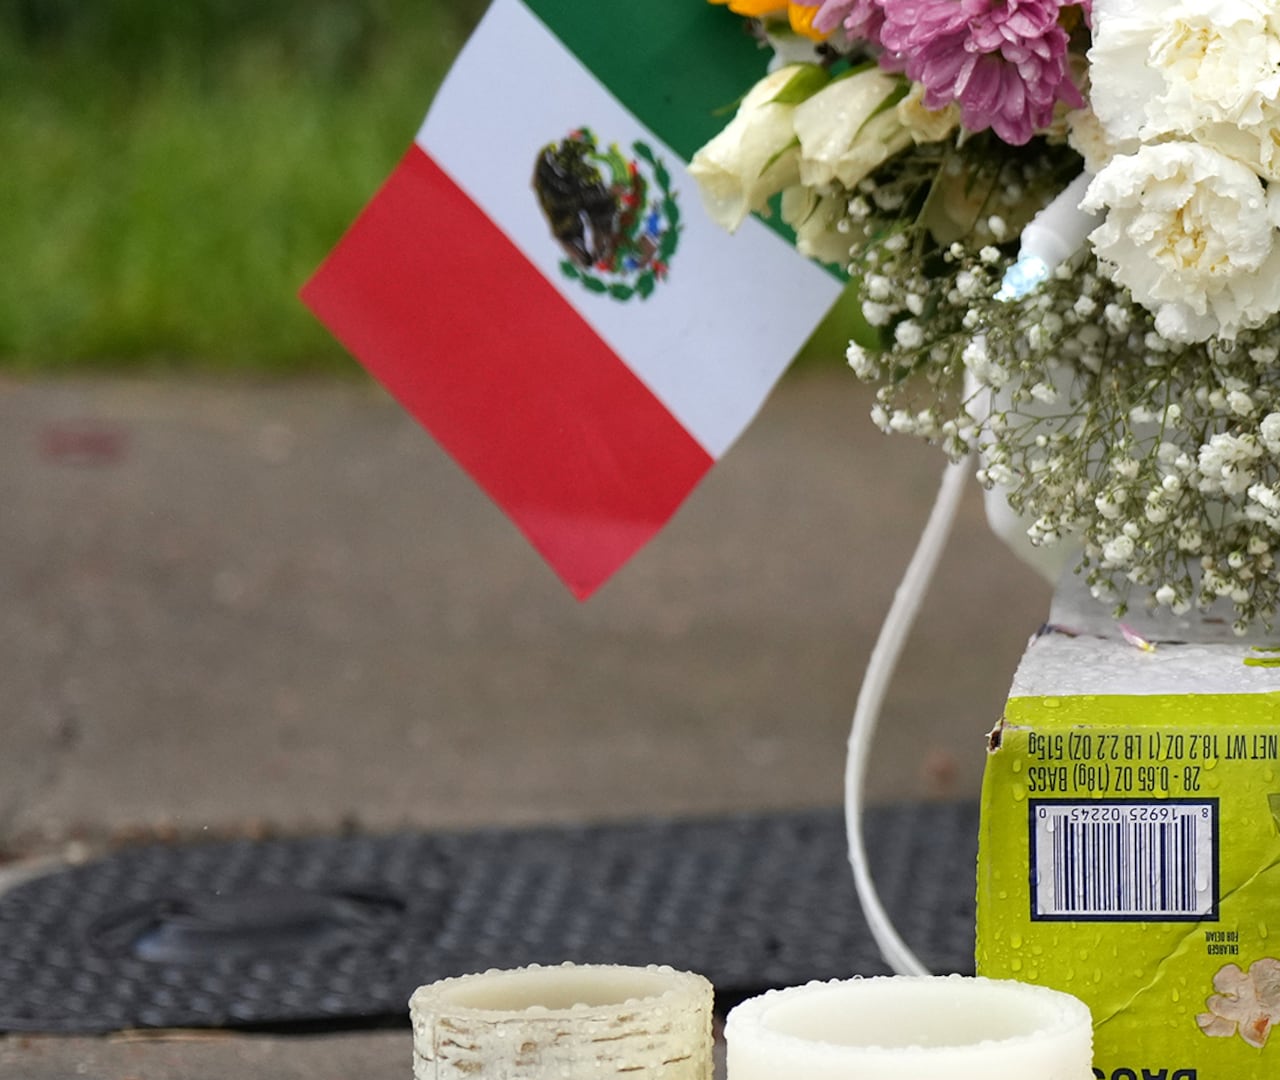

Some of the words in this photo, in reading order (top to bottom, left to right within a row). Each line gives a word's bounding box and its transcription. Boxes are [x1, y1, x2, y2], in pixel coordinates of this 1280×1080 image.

[1028, 733, 1062, 759] 515g
[1069, 732, 1091, 759] OZ)
[1098, 735, 1118, 759] 2.2
[1125, 735, 1141, 759] LB
[1149, 732, 1160, 759] (1
[1166, 735, 1183, 759] OZ
[1190, 735, 1219, 759] 18.2
[1225, 735, 1246, 759] WT
[1251, 735, 1277, 759] NET
[1028, 767, 1067, 791] BAGS
[1073, 763, 1109, 792] (18g)
[1115, 767, 1132, 791] OZ
[1139, 767, 1168, 791] 0.65
[1184, 767, 1200, 791] 28
[1040, 808, 1046, 817] 0
[1071, 808, 1119, 820] 02245
[1130, 808, 1178, 820] 16925
[1202, 808, 1208, 817] 8
[1206, 932, 1224, 942] DETAIL
[1208, 944, 1238, 954] ENLARGED
[1226, 932, 1238, 942] FOR
